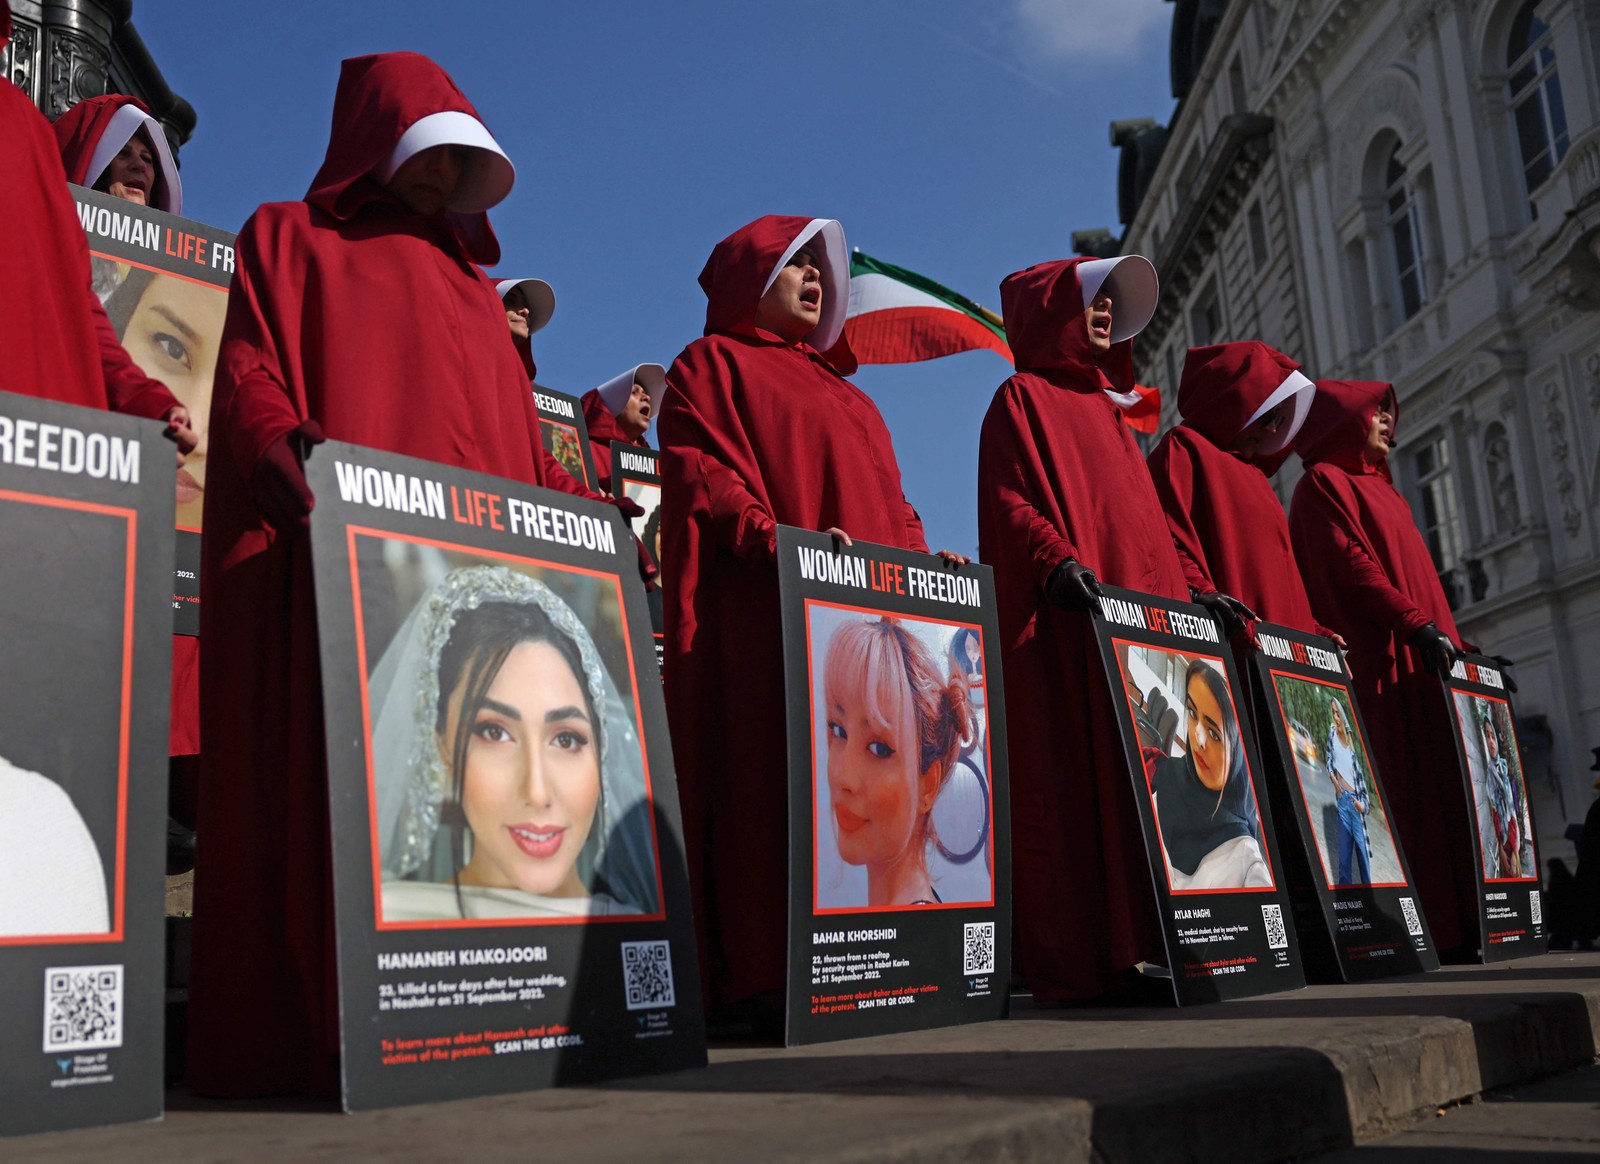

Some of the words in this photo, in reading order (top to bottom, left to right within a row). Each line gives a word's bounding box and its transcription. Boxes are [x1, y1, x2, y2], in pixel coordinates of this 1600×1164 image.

[76, 202, 160, 251] WOMAN
[166, 228, 208, 265] LIFE
[620, 452, 655, 475] WOMAN
[334, 461, 446, 520] WOMAN
[450, 486, 505, 531] LIFE
[508, 498, 616, 554] FREEDOM
[177, 570, 196, 579] 2022.
[798, 546, 866, 588] WOMAN
[870, 560, 905, 595] LIFE
[908, 566, 981, 608] FREEDOM
[1098, 596, 1146, 629] WOMAN
[1144, 606, 1170, 634] LIFE
[1168, 611, 1220, 643] FREEDOM
[1258, 633, 1294, 662] WOMAN
[1289, 641, 1310, 666] LIFE
[1306, 645, 1342, 673] FREEDOM
[1476, 665, 1504, 690] FREEDOM
[1174, 909, 1192, 920] AYLAR
[1193, 908, 1211, 918] HAGHI
[813, 931, 845, 944] BAHAR
[847, 928, 896, 942] KHORSHIDI
[378, 950, 455, 970] HANANEH
[459, 946, 547, 966] KIAKOJOORI
[812, 955, 822, 964] 22,
[824, 954, 846, 963] thrown
[847, 953, 861, 962] from
[868, 951, 890, 961] rooftop
[812, 966, 820, 976] by
[822, 964, 845, 974] security
[847, 963, 866, 973] agents
[875, 960, 891, 968] Rabat
[893, 959, 909, 967] Karim
[398, 981, 427, 995] killed
[428, 984, 436, 993] a
[438, 980, 457, 993] few
[459, 978, 482, 994] days
[484, 976, 506, 991] after
[508, 976, 524, 988] her
[822, 975, 829, 984] 21
[831, 973, 863, 984] September
[864, 971, 881, 979] 2022.
[379, 999, 390, 1010] in
[438, 996, 451, 1006] on
[467, 991, 517, 1006] September
[820, 994, 836, 1003] learn
[855, 991, 872, 999] about
[873, 990, 890, 998] Bahar
[892, 988, 903, 996] and
[920, 985, 938, 993] victims
[812, 1006, 819, 1014] of
[820, 1005, 829, 1013] the
[858, 1001, 875, 1009] SCAN
[876, 999, 887, 1007] THE
[888, 998, 897, 1006] QR
[898, 996, 915, 1005] CODE.
[381, 1040, 394, 1051] To
[396, 1037, 422, 1049] learn
[454, 1032, 482, 1045] about
[527, 1025, 545, 1037] and
[382, 1051, 417, 1065] victims
[419, 1049, 430, 1062] of
[432, 1048, 449, 1060] the
[494, 1040, 521, 1054] SCAN
[523, 1038, 540, 1051] THE
[542, 1036, 556, 1049] QR
